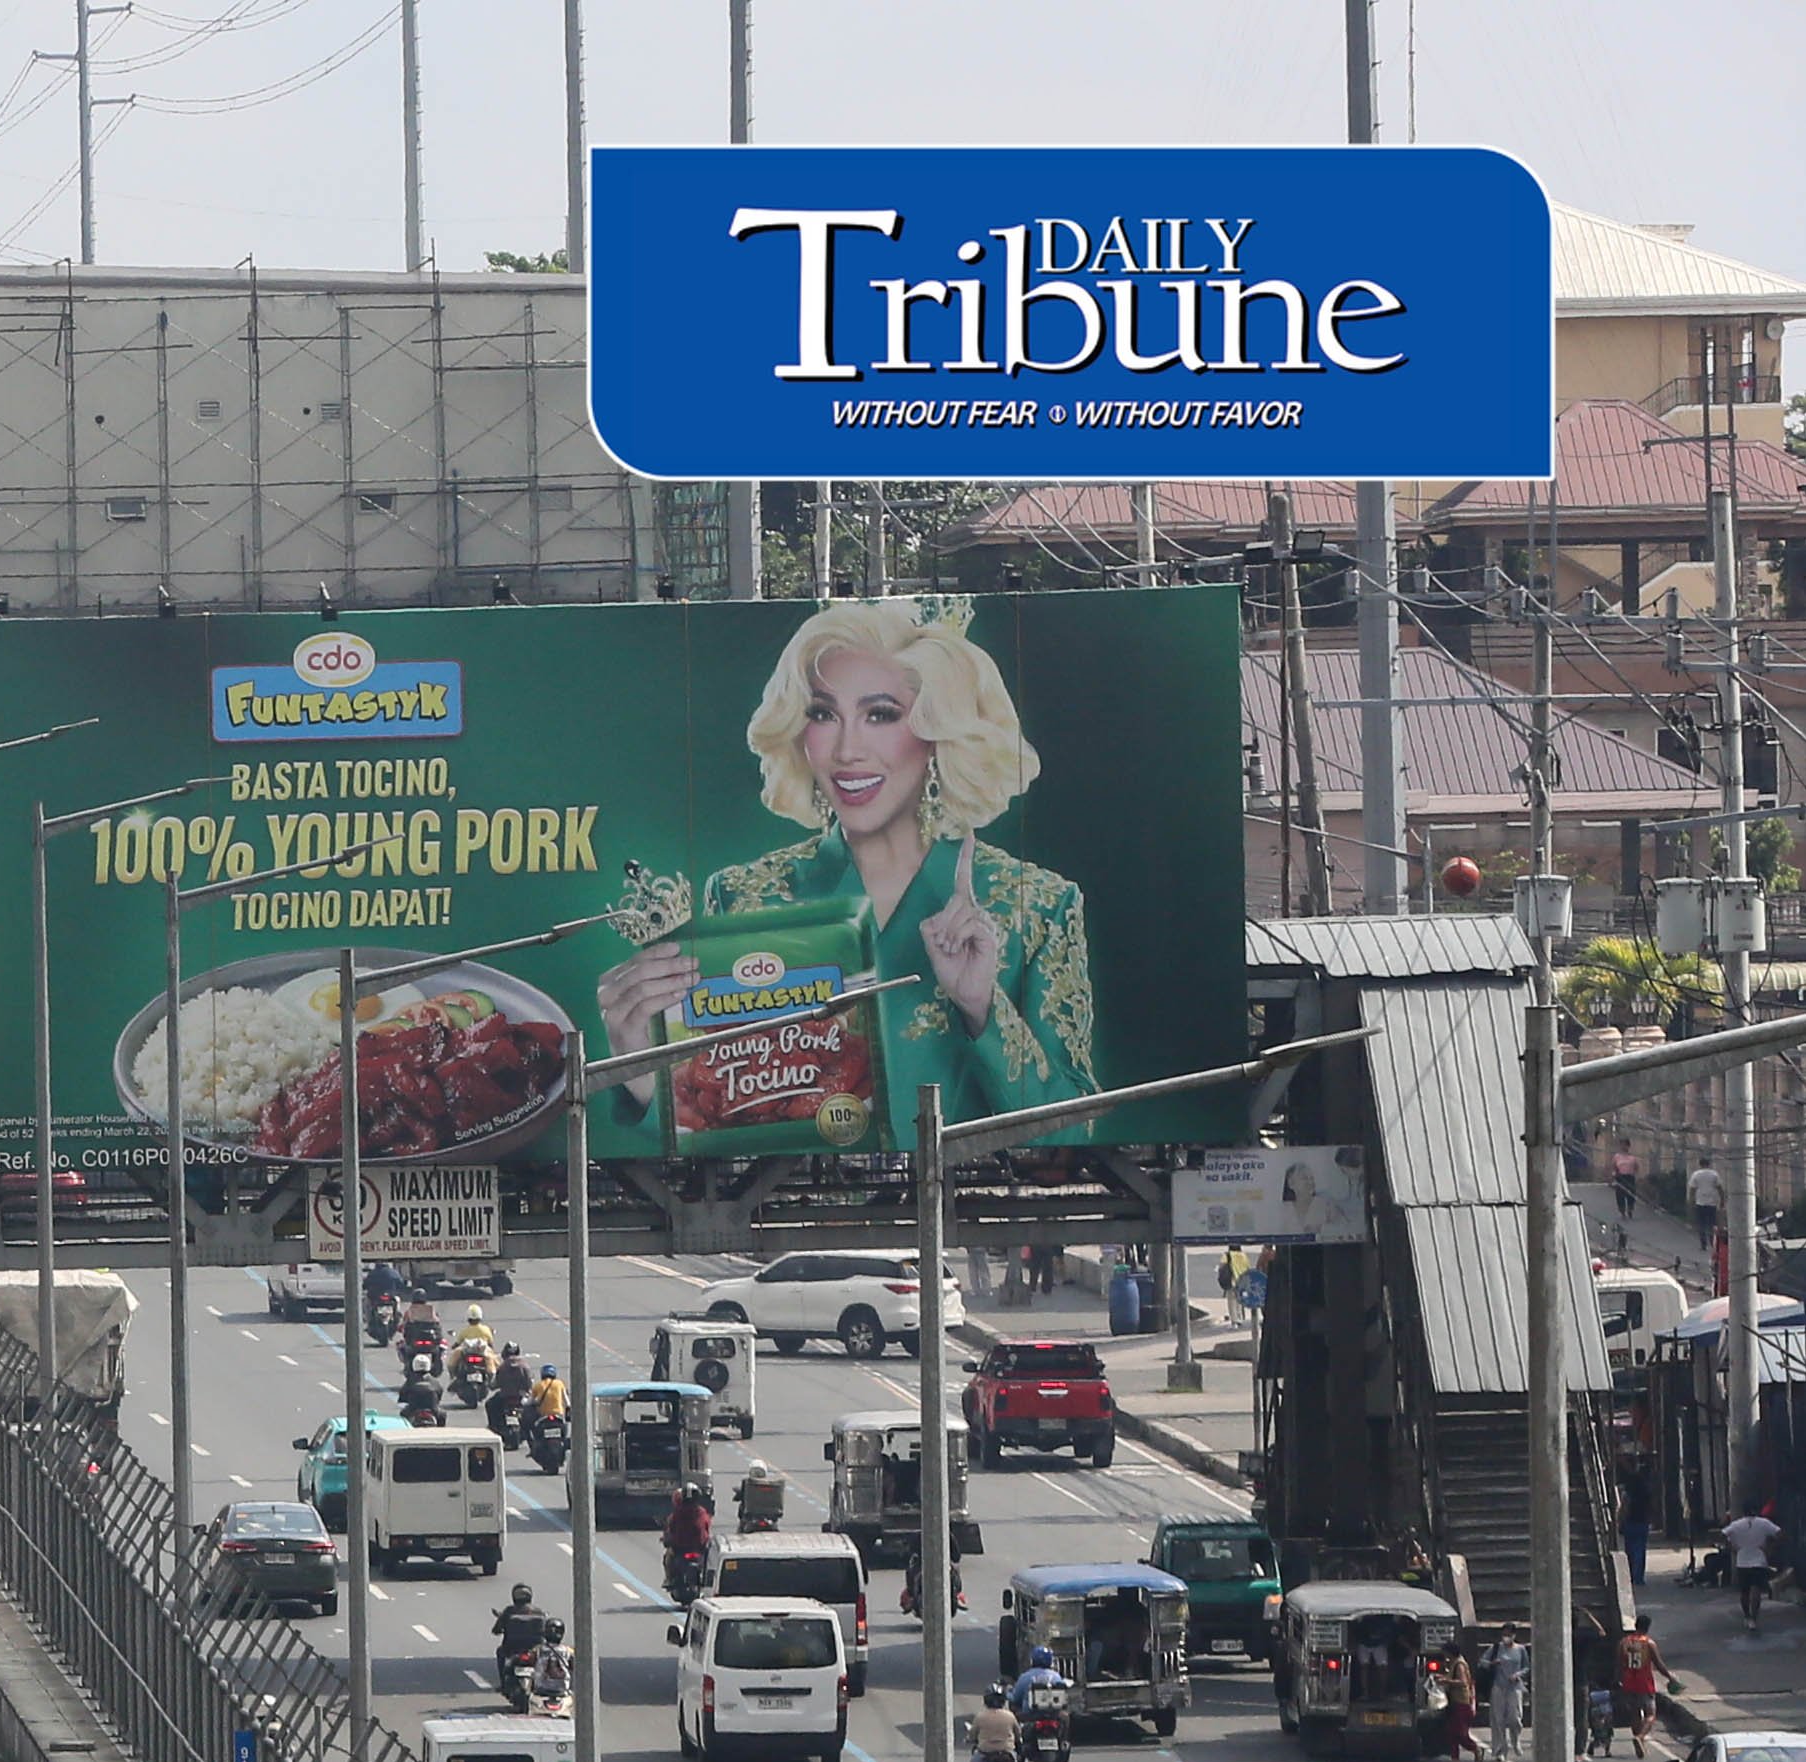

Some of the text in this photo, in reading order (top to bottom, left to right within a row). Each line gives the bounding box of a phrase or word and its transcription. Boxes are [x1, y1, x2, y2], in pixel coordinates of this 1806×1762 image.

[307, 643, 362, 671] cdo
[230, 756, 457, 803] BASTA TOCINO,
[89, 805, 600, 885] 100% YOUNG PORK
[230, 887, 453, 931] TOCINO DAPAT!
[740, 959, 777, 978] cdo
[779, 1024, 841, 1054] Pork
[715, 1059, 822, 1101] Tocino
[10, 1129, 20, 1139] of
[22, 1129, 34, 1138] 52
[70, 1127, 102, 1139] ending
[104, 1126, 134, 1137] March
[51, 1115, 94, 1125] umerator
[454, 1094, 546, 1141] Serving Suggestion
[82, 1145, 248, 1168] C0116P00426C
[389, 1169, 492, 1201] MAXIMUM
[388, 1206, 494, 1239] SPEED LIMIT
[383, 1240, 411, 1251] PLEASE
[412, 1239, 442, 1250] FOLLOW
[444, 1239, 468, 1250] SPEED
